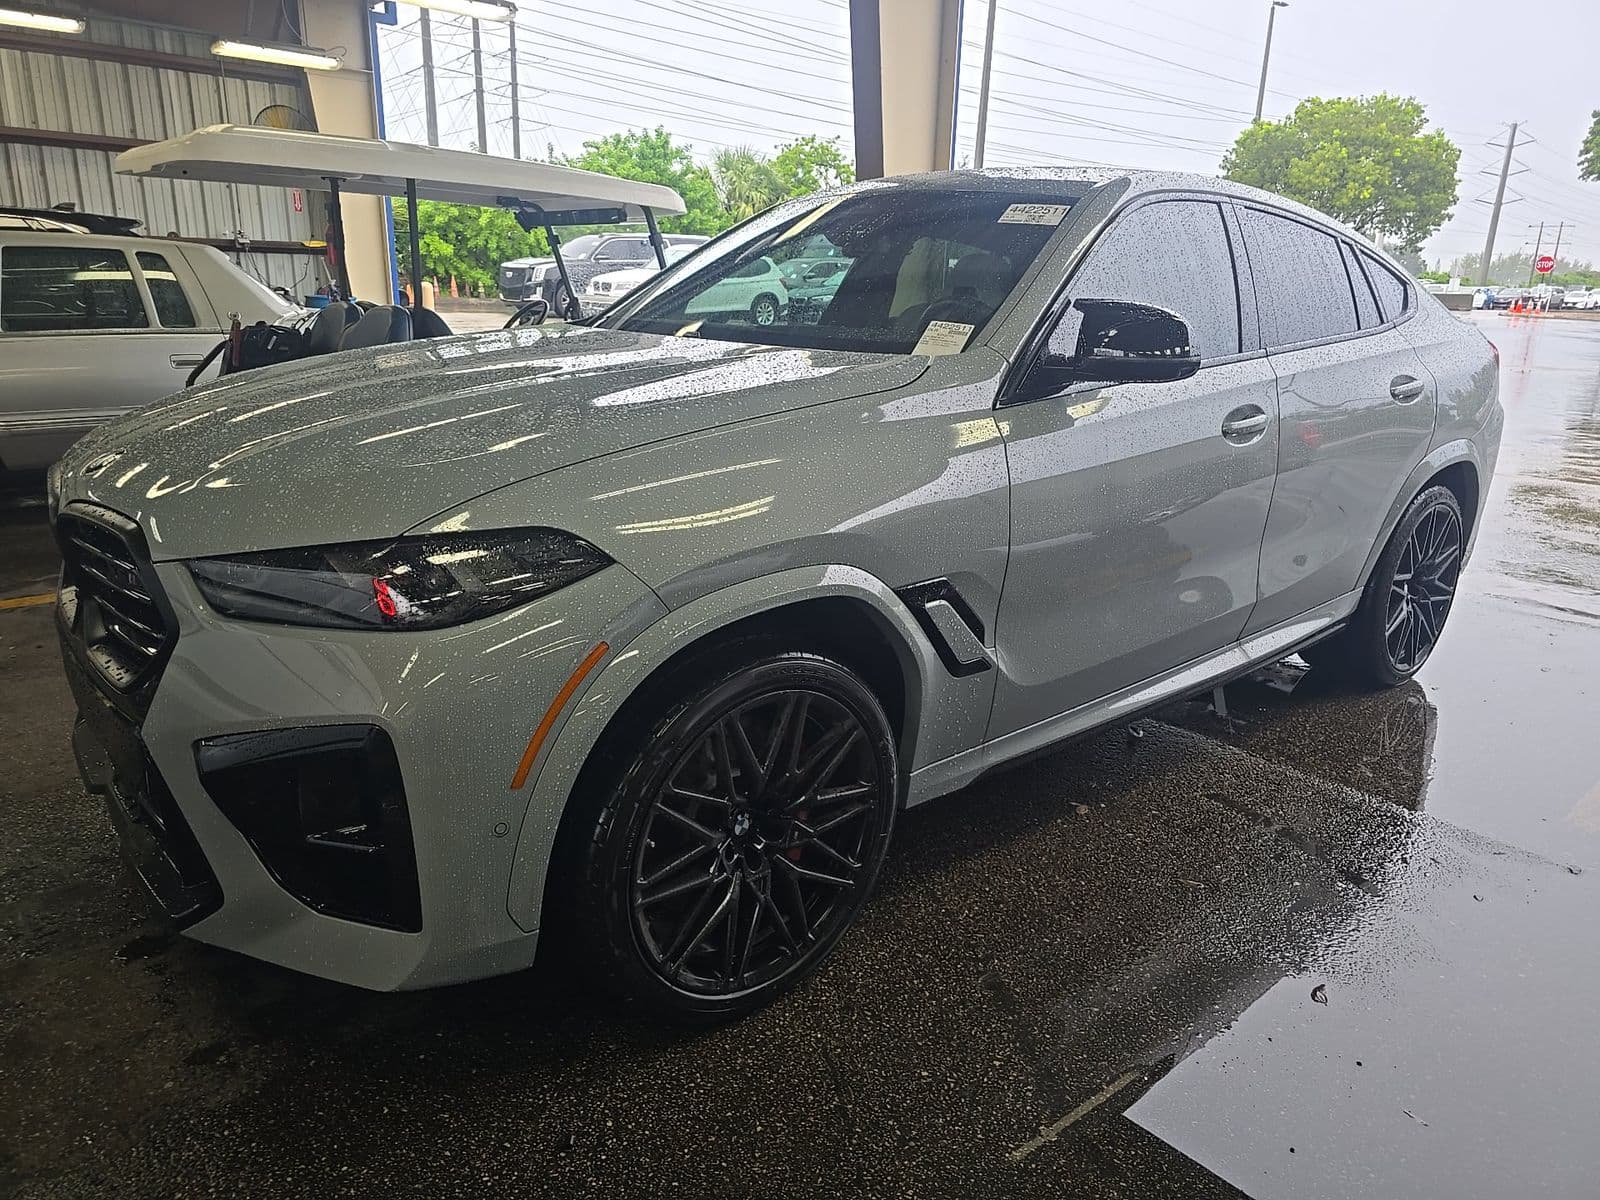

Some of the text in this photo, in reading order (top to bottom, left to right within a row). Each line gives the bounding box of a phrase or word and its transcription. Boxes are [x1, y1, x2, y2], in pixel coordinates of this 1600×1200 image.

[1009, 205, 1067, 215] 4422511
[1536, 260, 1554, 269] STOP
[931, 322, 972, 332] 4422511
